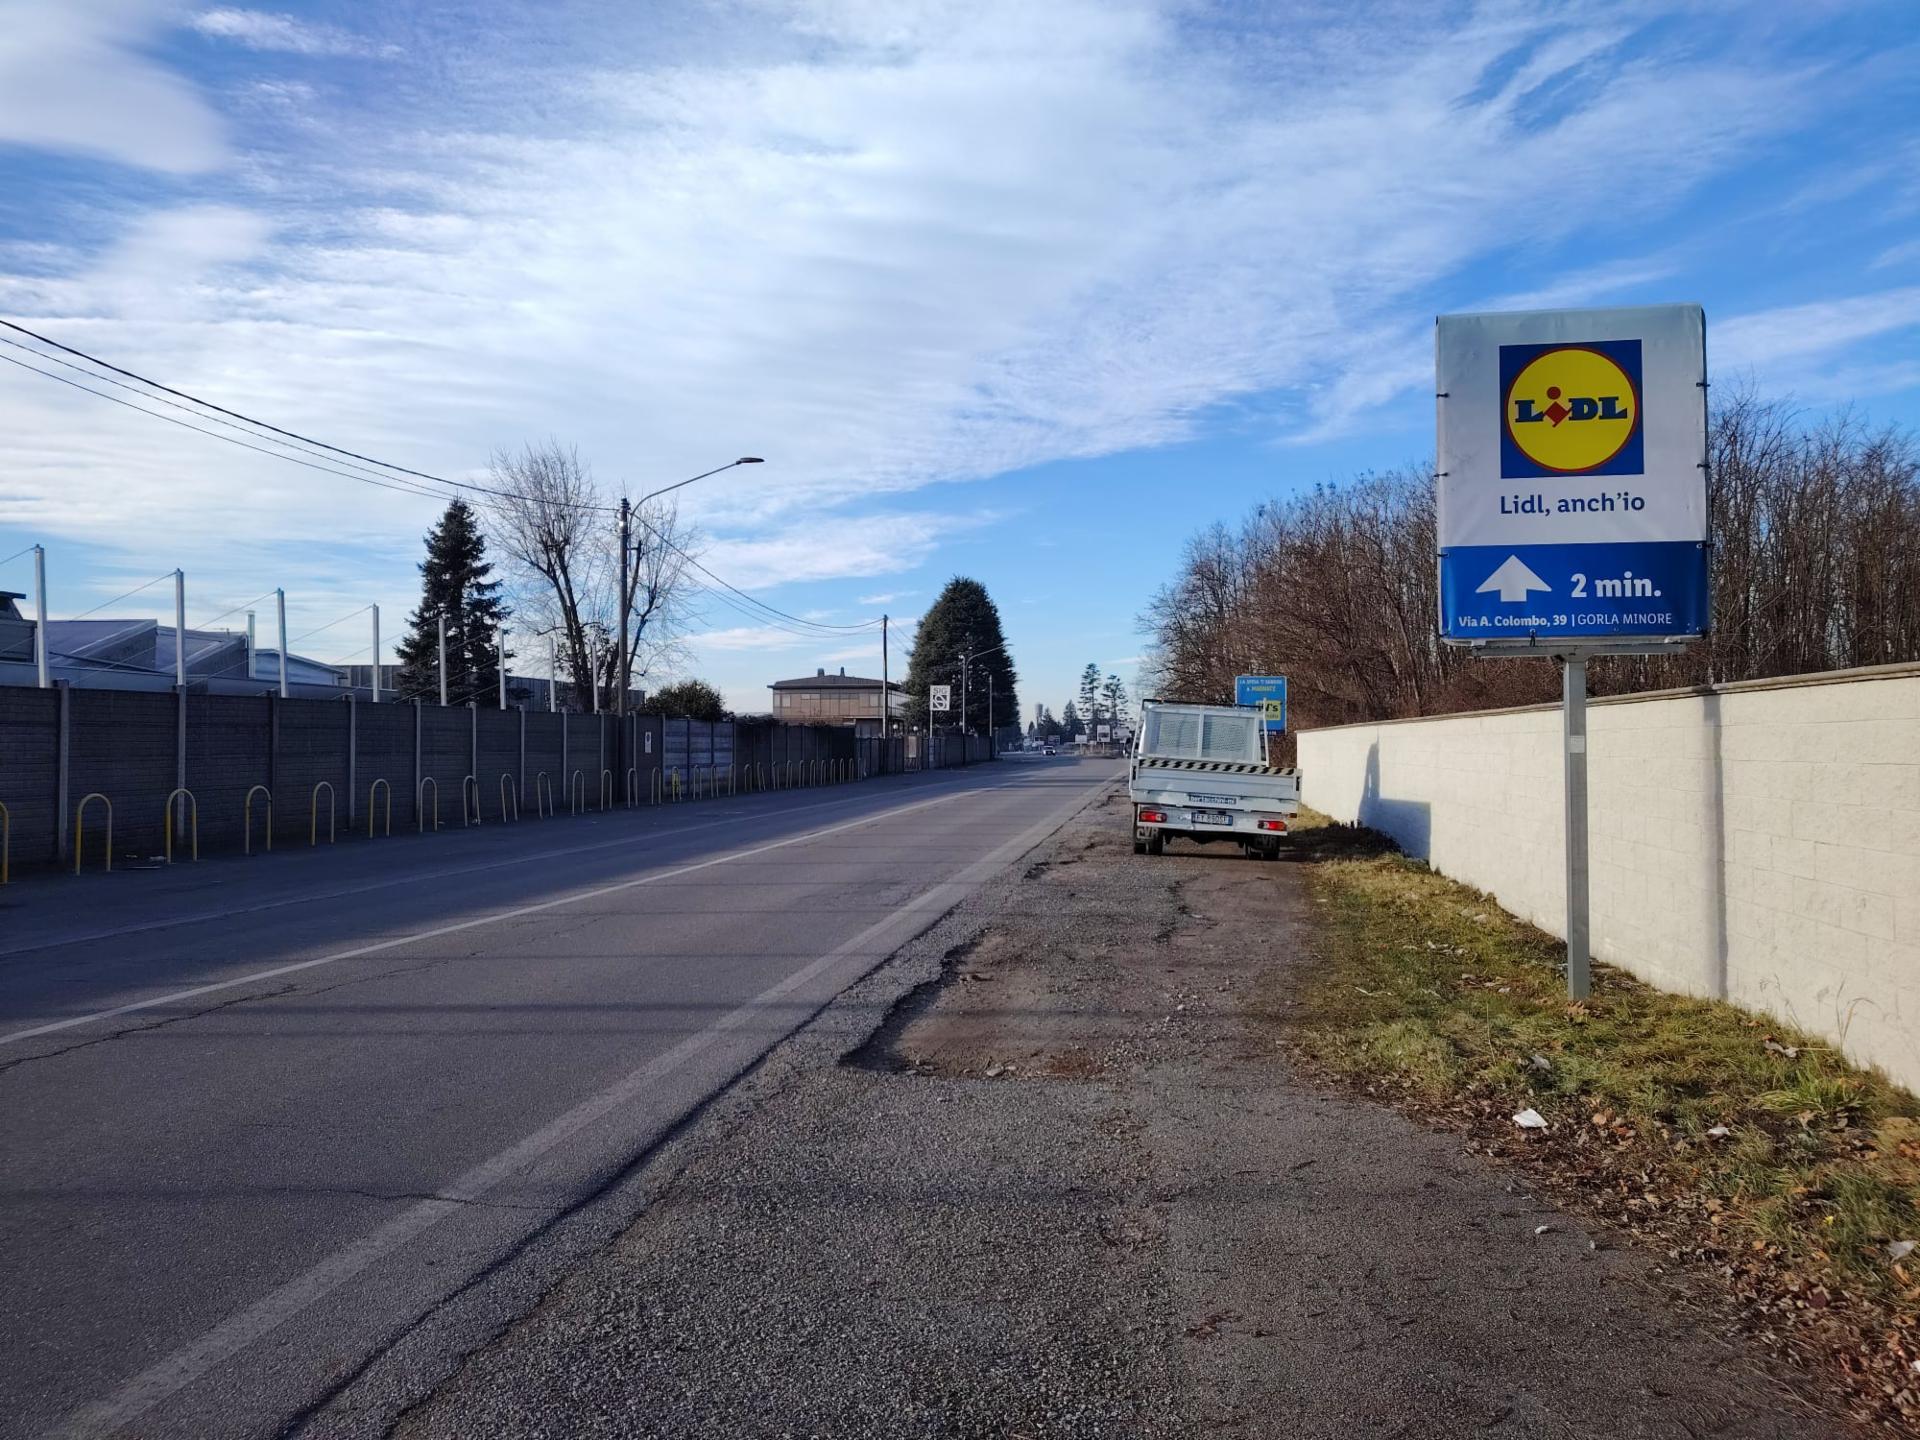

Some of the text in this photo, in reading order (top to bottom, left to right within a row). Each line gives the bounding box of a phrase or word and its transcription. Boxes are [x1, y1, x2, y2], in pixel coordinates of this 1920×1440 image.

[1500, 491, 1646, 516] Lidl, anch'io
[1570, 571, 1663, 598] 2 min.
[1458, 615, 1478, 627] Via
[1479, 616, 1492, 627] A.
[1494, 614, 1551, 627] Colombo,
[1552, 614, 1568, 626] 39
[1577, 612, 1619, 625] GORLA
[1622, 612, 1673, 625] MINORE
